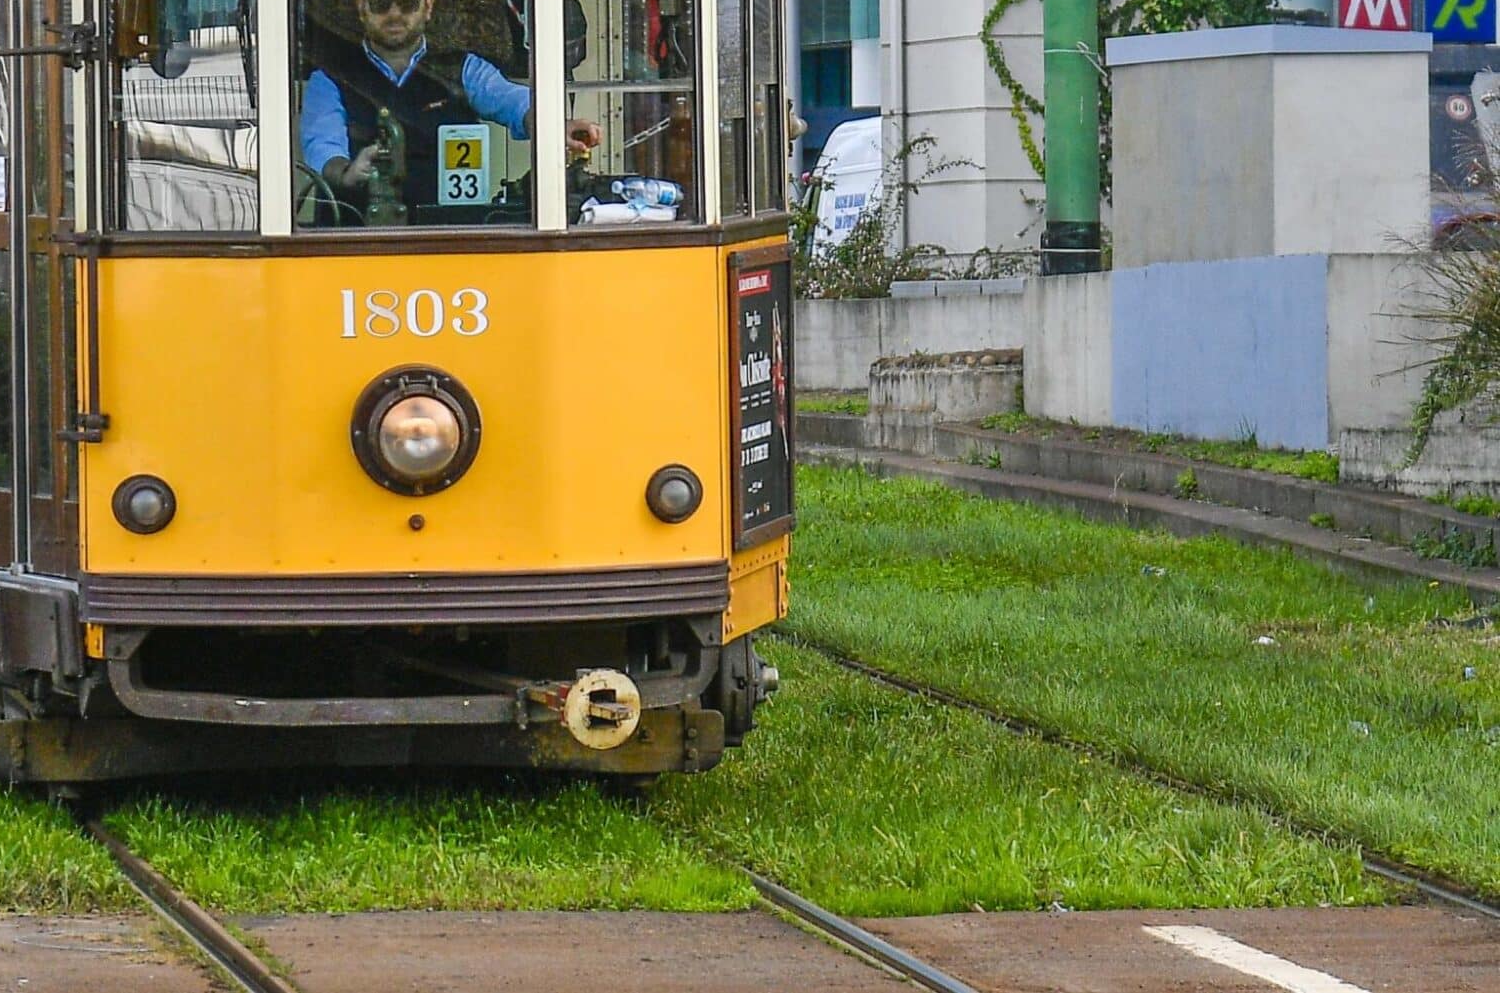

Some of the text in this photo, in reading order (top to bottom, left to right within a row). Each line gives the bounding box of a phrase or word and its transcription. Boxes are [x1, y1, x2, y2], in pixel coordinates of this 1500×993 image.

[455, 142, 471, 168] 2
[448, 173, 479, 199] 33
[340, 287, 490, 339] 1803
